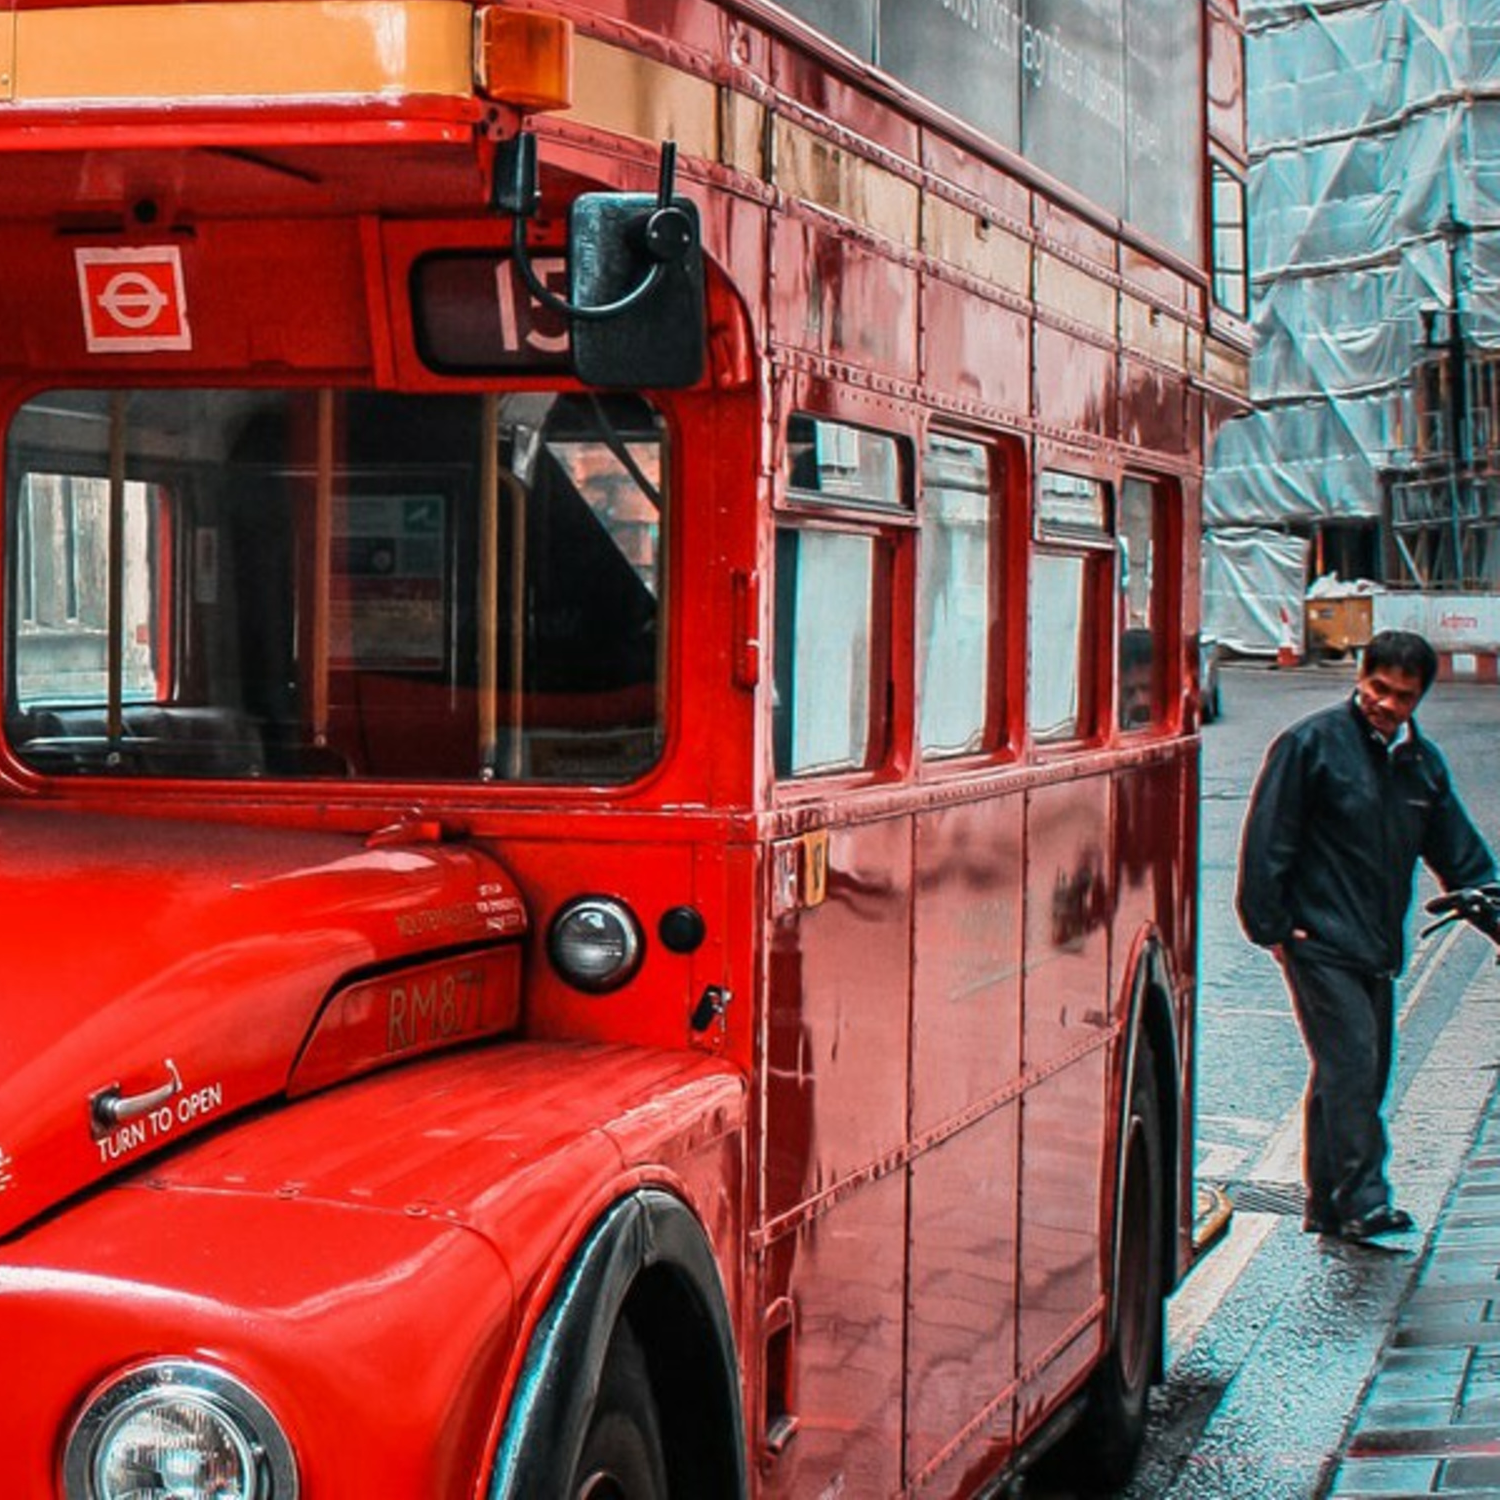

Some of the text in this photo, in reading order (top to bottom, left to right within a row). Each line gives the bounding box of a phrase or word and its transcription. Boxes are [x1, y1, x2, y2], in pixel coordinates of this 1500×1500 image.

[388, 970, 485, 1053] RM871
[97, 1082, 222, 1163] TURN TO OPEN
